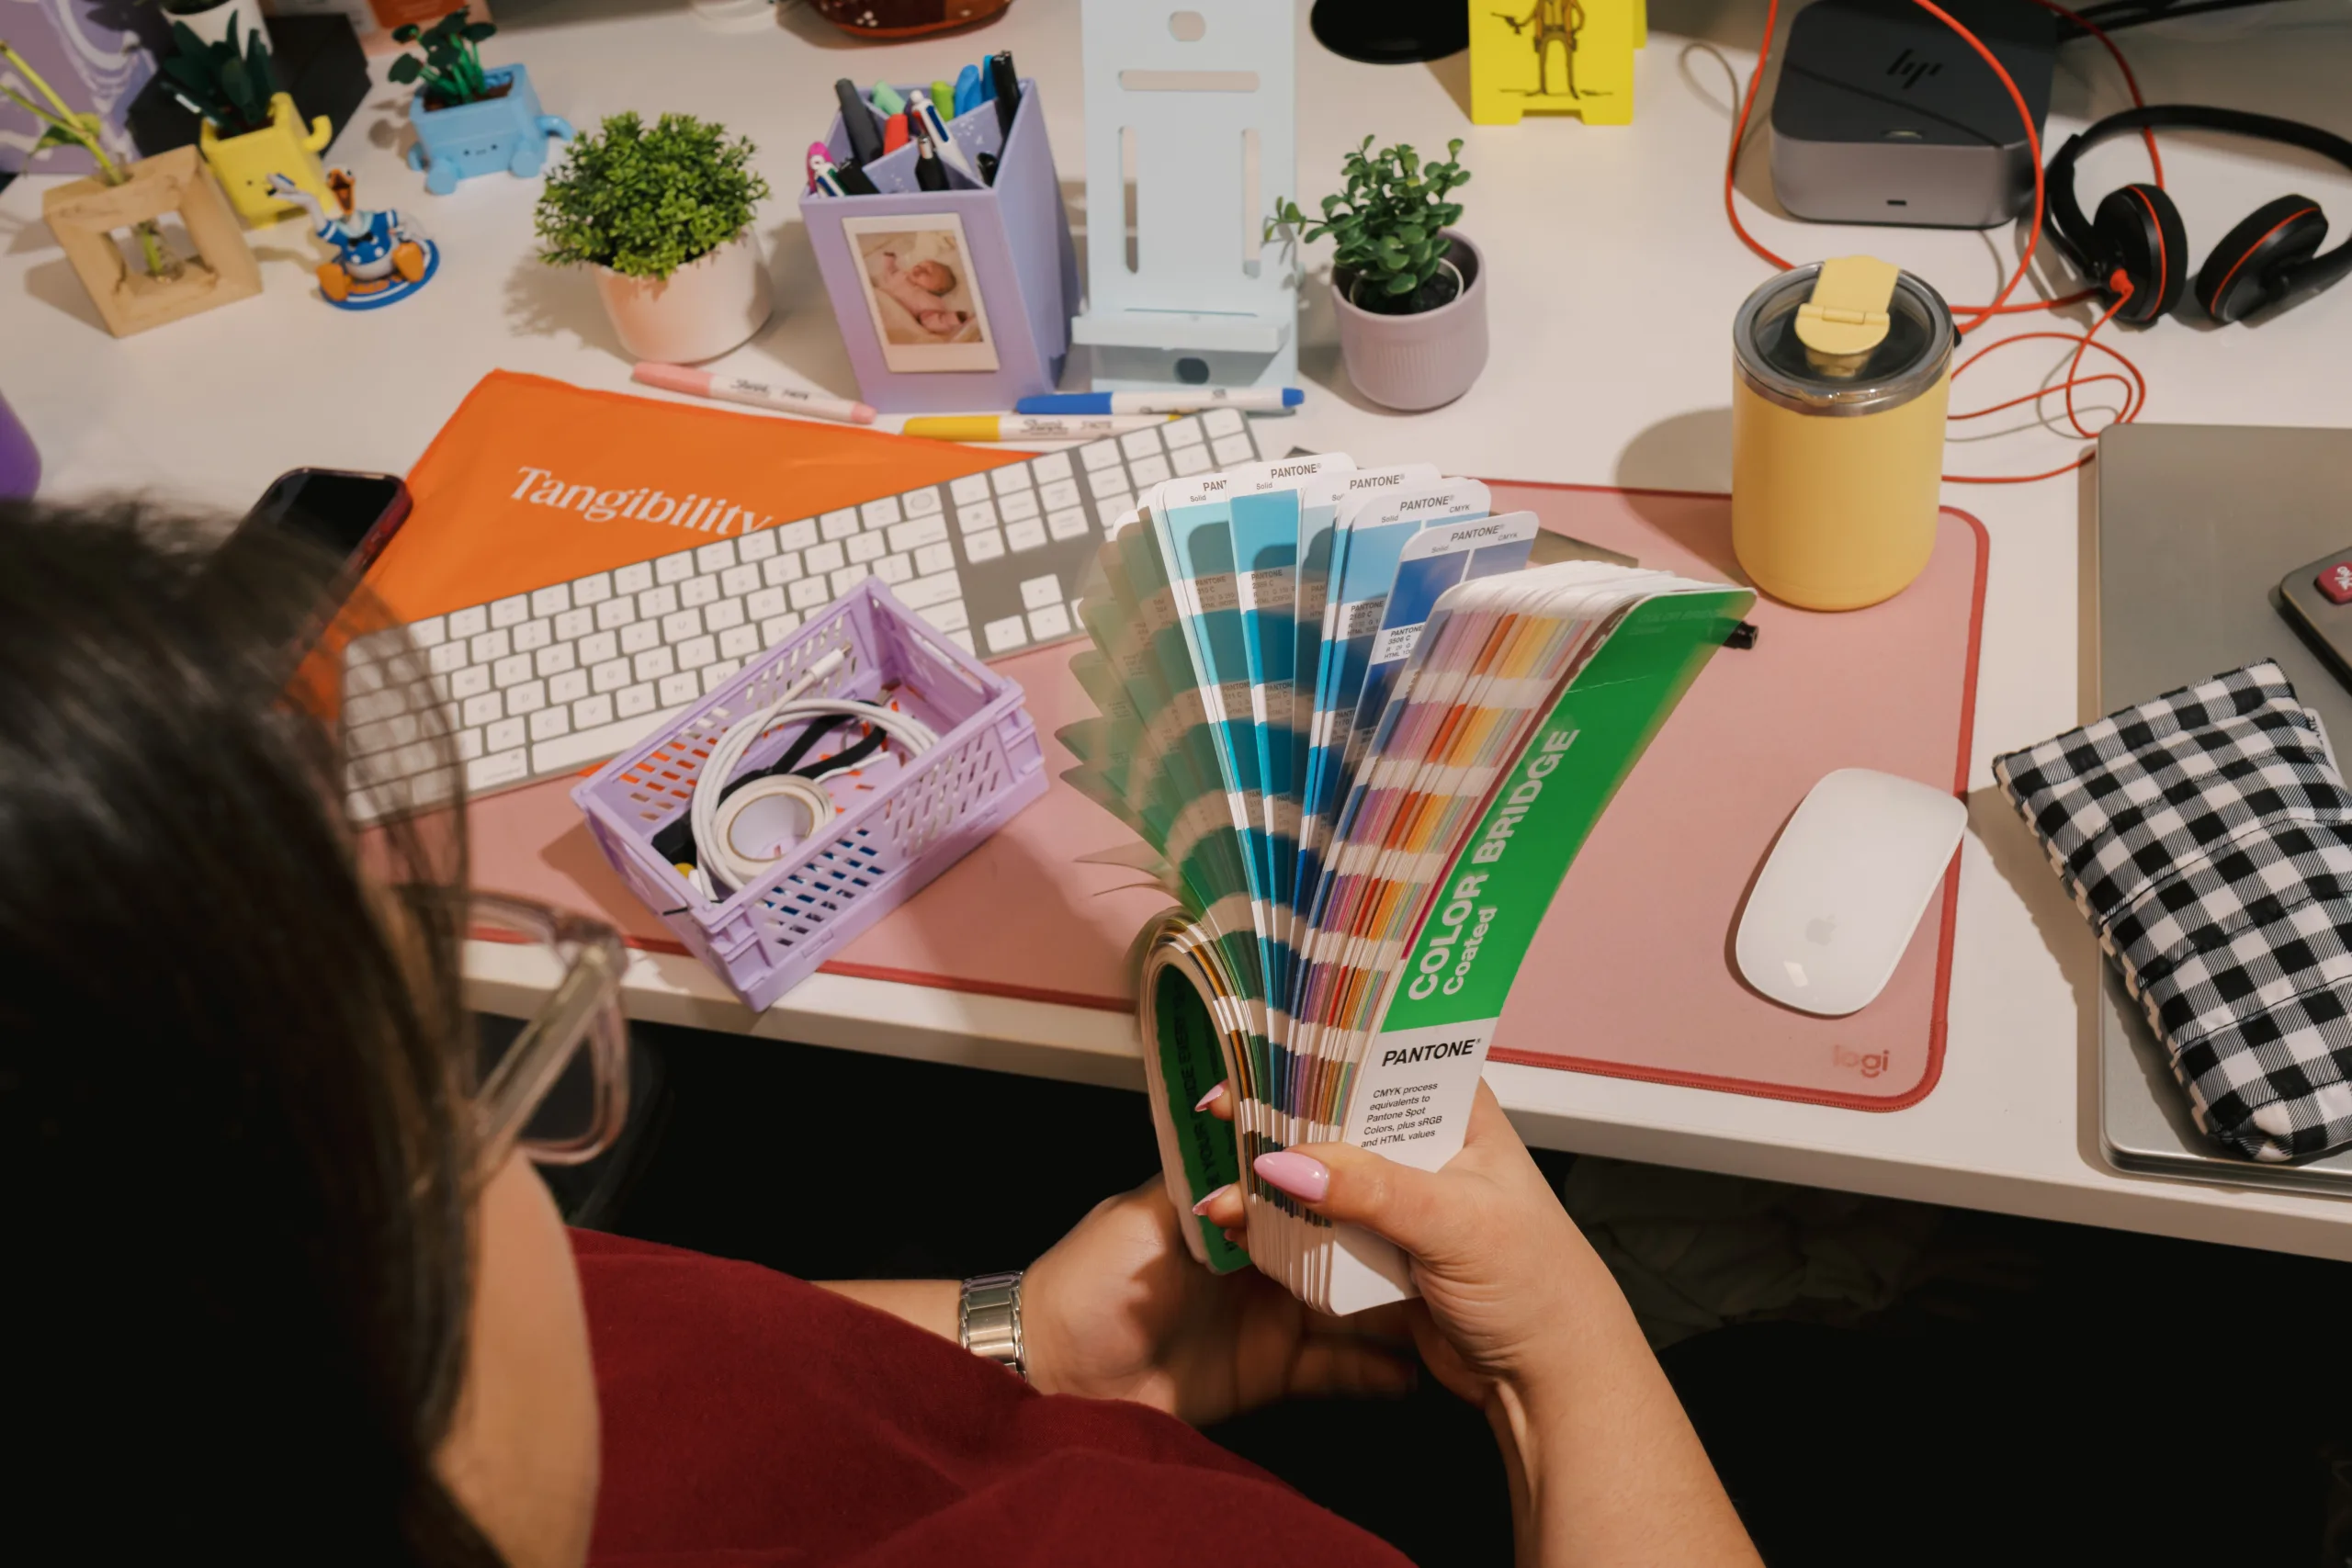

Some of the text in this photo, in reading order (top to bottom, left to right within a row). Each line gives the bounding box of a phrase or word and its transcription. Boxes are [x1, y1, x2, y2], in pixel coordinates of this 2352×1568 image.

[1256, 482, 1273, 491] Solid
[511, 466, 775, 535] Tangibility
[1381, 503, 1470, 524] Solid CMYK
[1430, 532, 1519, 554] Solid CMYK
[1195, 575, 1227, 586] PANTONE
[1251, 569, 1283, 581] PANTONE
[1351, 601, 1385, 613] PANTONE
[1390, 625, 1423, 637] PANTONE
[1384, 650, 1400, 660] HTML
[1408, 728, 1581, 1000] COLOR BRIDGE
[1442, 907, 1498, 996] Coated
[1832, 1044, 1890, 1078] logi
[1373, 1083, 1438, 1099] CMYK process
[1369, 1095, 1430, 1111] equivalents to
[1367, 1107, 1426, 1122] Pantone Spot
[1363, 1115, 1442, 1135] Colors, plus sRGB
[1361, 1129, 1436, 1148] and HTML values
